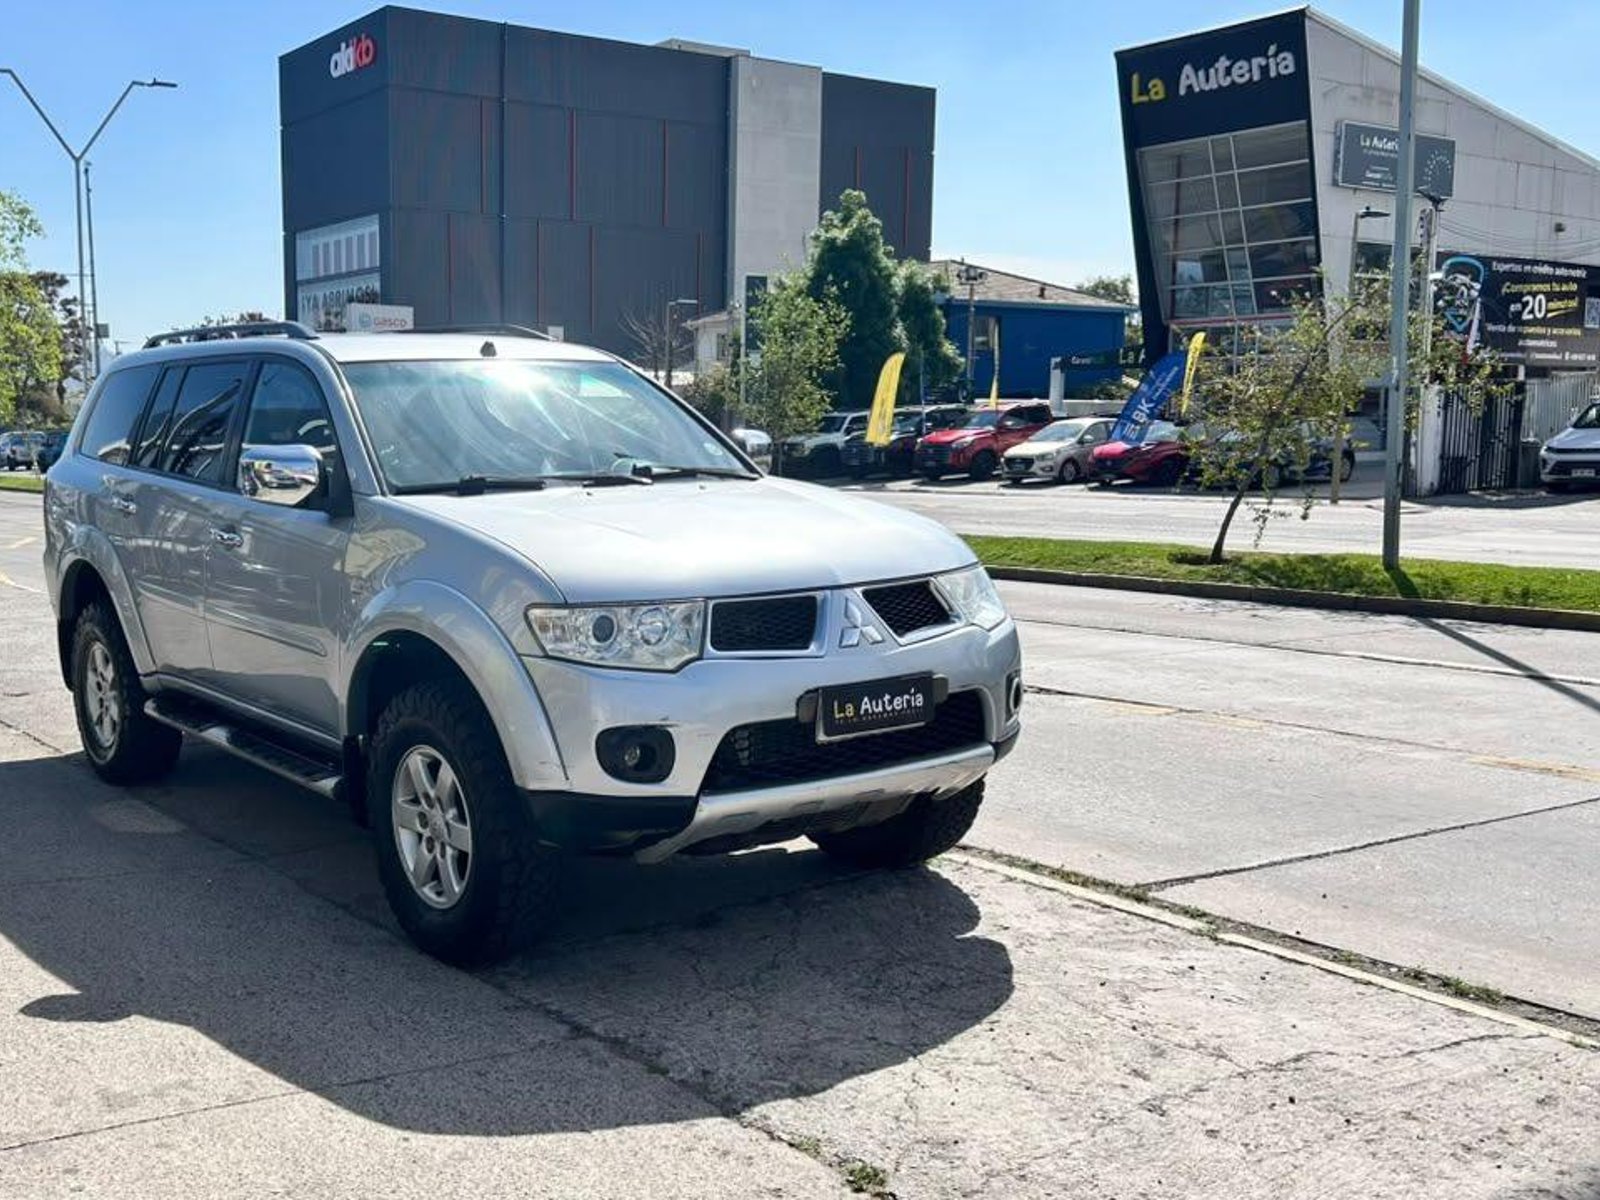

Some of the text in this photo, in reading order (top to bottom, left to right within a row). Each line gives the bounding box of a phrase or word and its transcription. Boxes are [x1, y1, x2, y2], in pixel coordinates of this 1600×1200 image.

[1131, 43, 1296, 104] La Autería
[1360, 134, 1399, 151] La Auterí
[1521, 293, 1547, 320] 20
[833, 700, 855, 719] La
[860, 687, 924, 715] Autería
